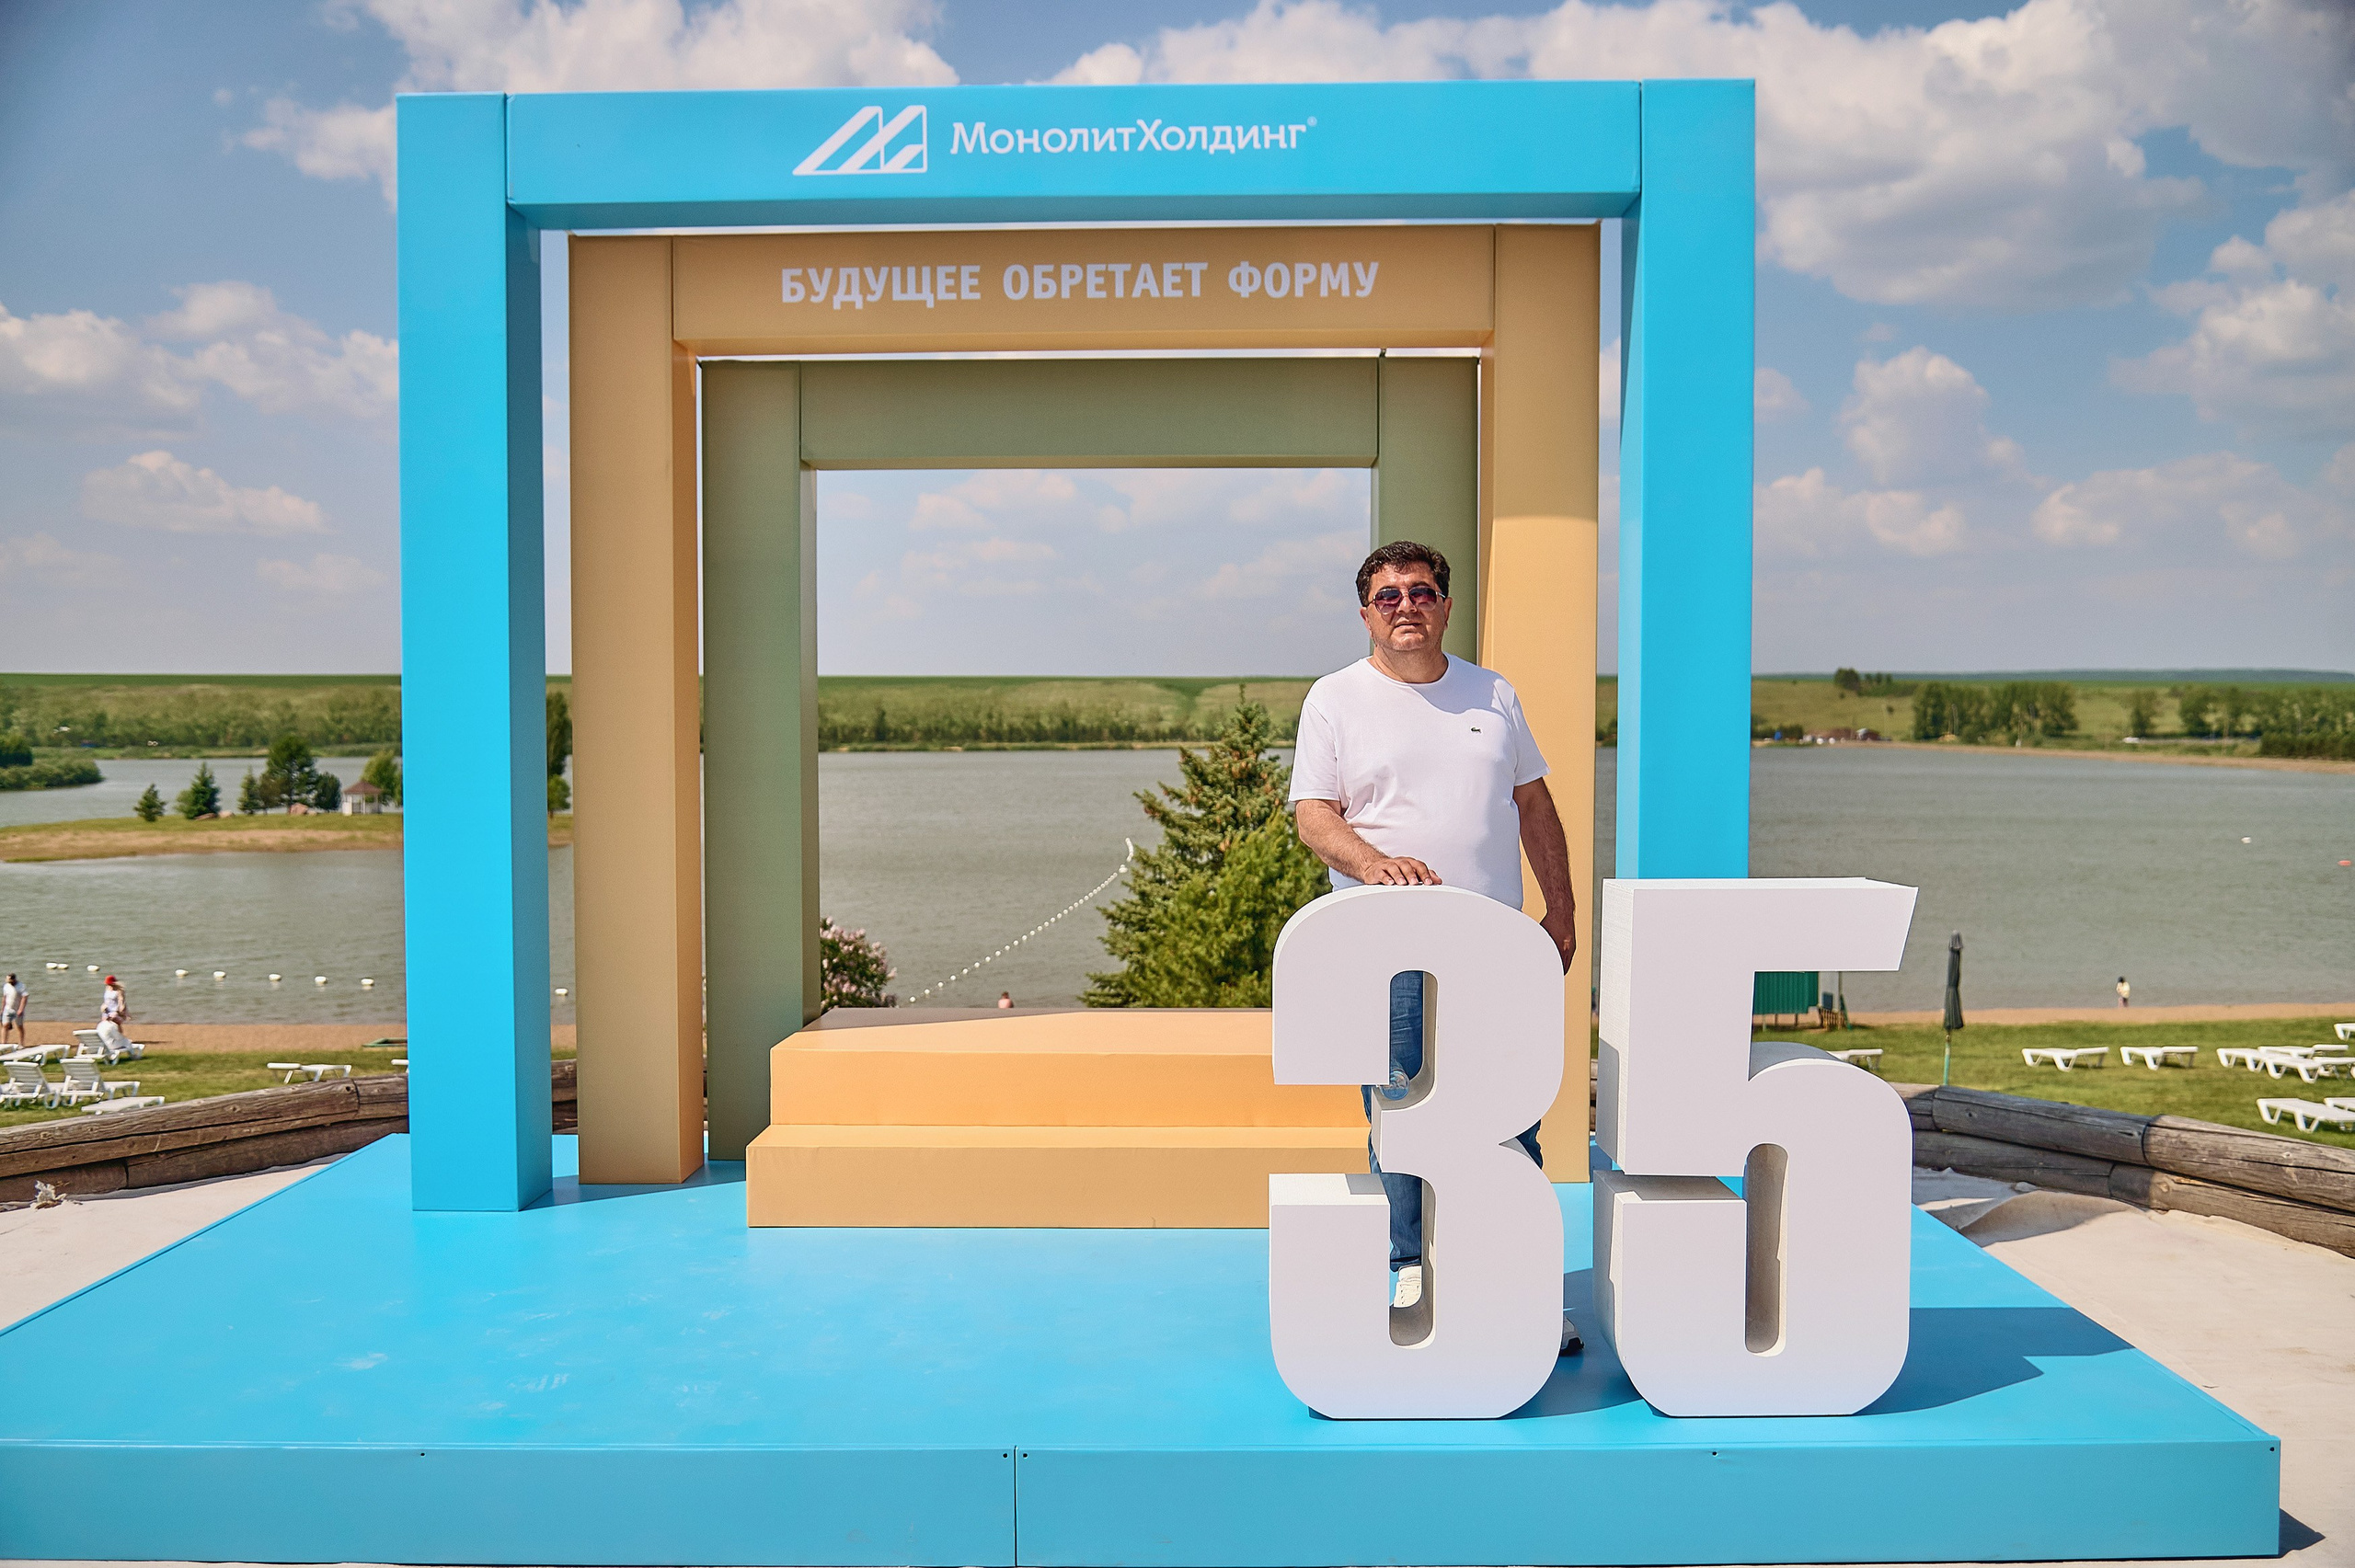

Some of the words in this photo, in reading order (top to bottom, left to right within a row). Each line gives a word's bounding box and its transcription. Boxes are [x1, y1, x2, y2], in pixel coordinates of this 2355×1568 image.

[781, 265, 982, 310] БУДУЩЕЕ
[1000, 262, 1208, 301] ОБРЕТАЕТ
[1227, 261, 1380, 299] ФОРМУ
[1269, 877, 1918, 1418] 35
